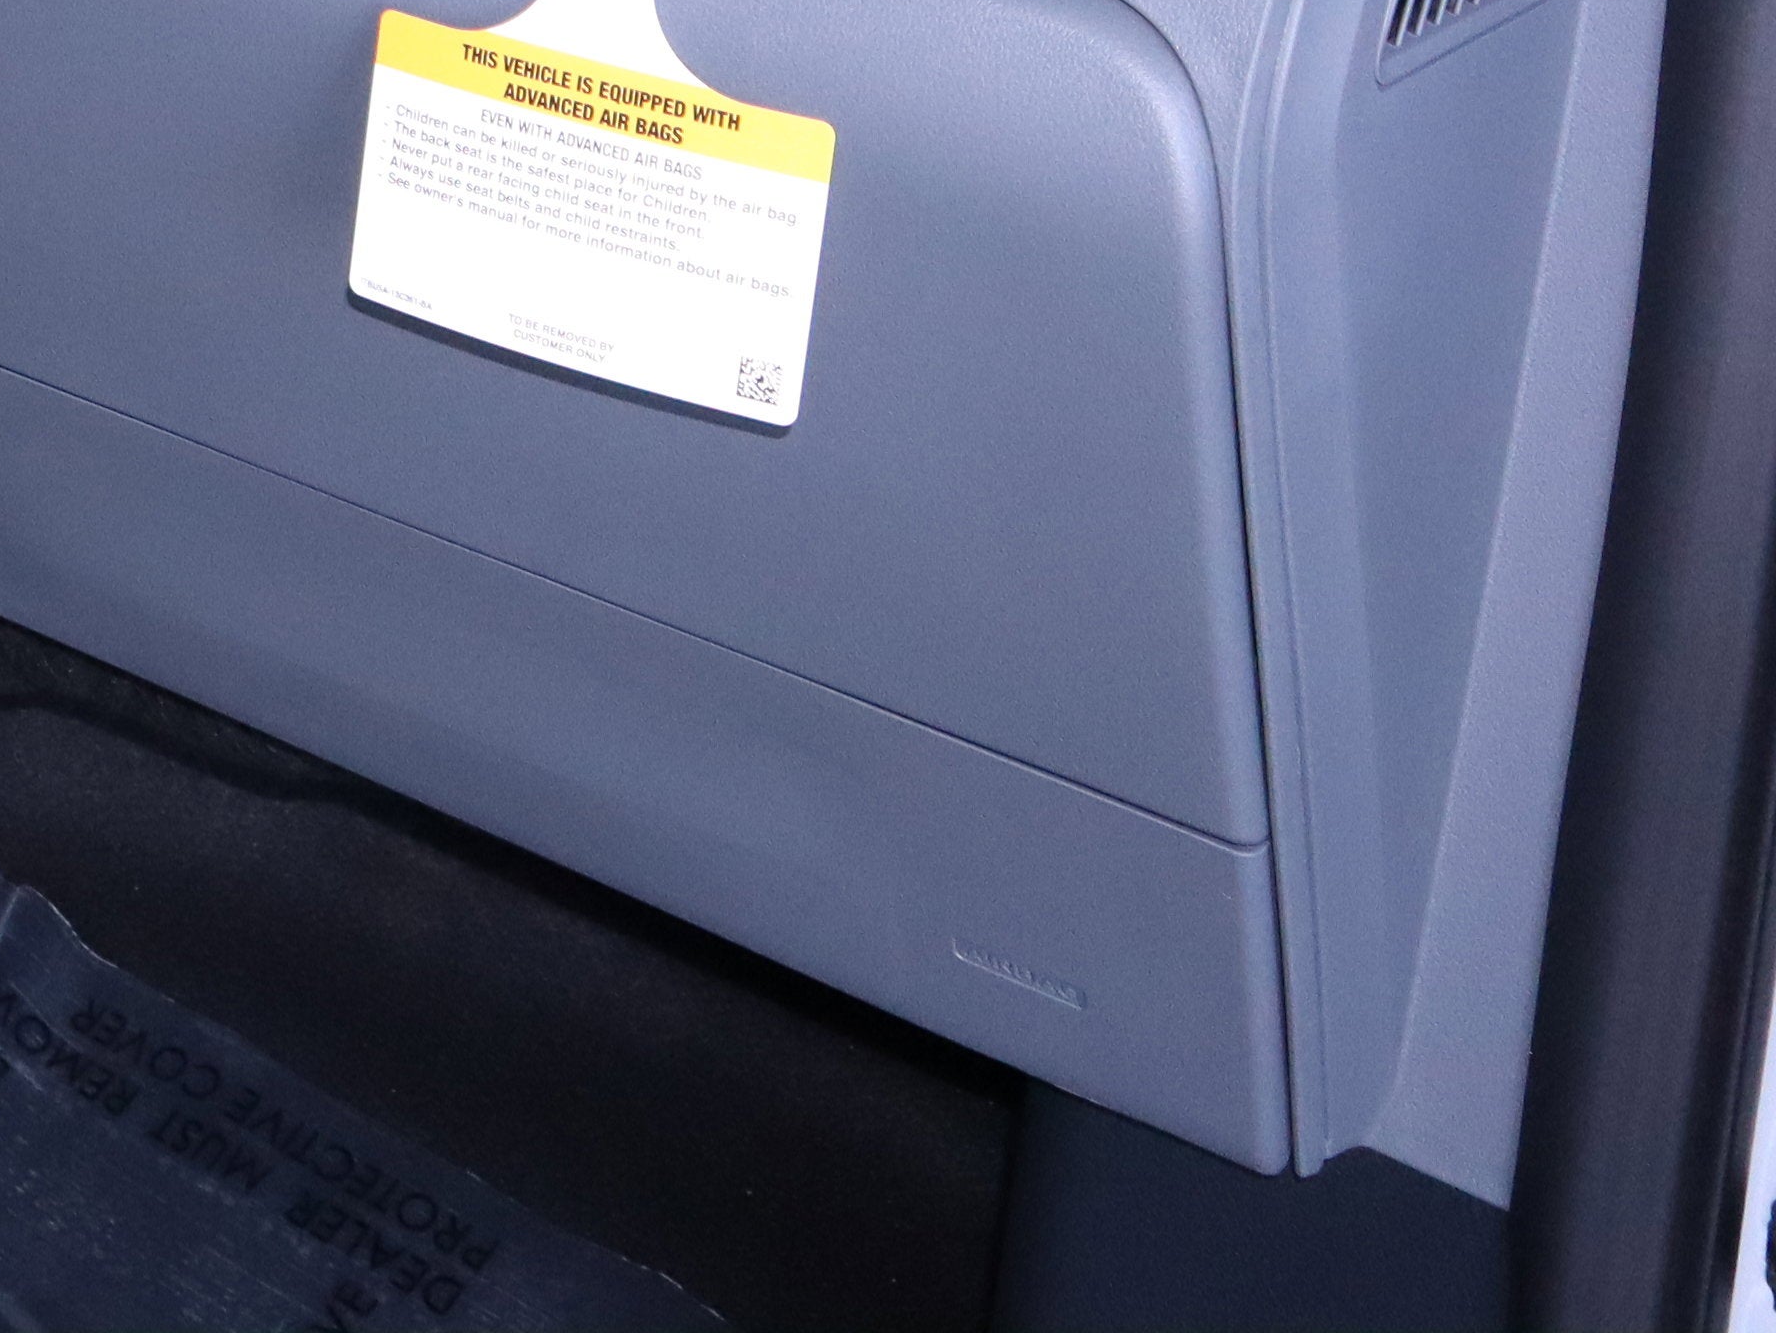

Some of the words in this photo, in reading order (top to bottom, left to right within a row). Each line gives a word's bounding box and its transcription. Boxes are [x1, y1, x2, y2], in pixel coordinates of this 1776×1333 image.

[462, 43, 499, 70] THIS
[503, 54, 572, 90] VEHICLE
[576, 75, 594, 95] IS
[598, 80, 687, 119] EQUIPPED
[692, 103, 741, 132] WITH
[503, 82, 595, 122] ADVANCED
[598, 108, 630, 132] AIR
[635, 116, 684, 145] BAGS
[392, 137, 428, 160] Never
[431, 153, 453, 168] put
[455, 161, 464, 172] a
[467, 165, 494, 181] rear
[498, 171, 541, 198] facing
[544, 188, 580, 206] child
[583, 199, 614, 216] seat
[618, 207, 632, 220] in
[637, 211, 660, 228] the
[394, 119, 417, 139] The
[420, 129, 451, 150] back
[454, 142, 482, 160] seat
[486, 152, 497, 164] is
[502, 155, 523, 172] the
[527, 164, 570, 185] safest
[573, 178, 613, 197] place
[617, 187, 638, 203] for
[395, 103, 449, 131] Children
[452, 124, 477, 139] can
[480, 130, 497, 146] be
[500, 136, 538, 158] killed
[541, 151, 556, 162] or
[560, 156, 628, 185] seriously
[632, 175, 685, 197] injured
[689, 187, 708, 206] by
[713, 194, 737, 210] the
[742, 203, 762, 215] air
[480, 108, 514, 130] EVEN
[518, 119, 553, 142] WITH
[555, 130, 630, 162] ADVANCED
[633, 151, 659, 170] AIR
[663, 158, 703, 181] BAGS
[387, 171, 411, 190] See
[413, 183, 464, 208] owner's
[468, 200, 518, 224] manual
[522, 214, 541, 231] for
[545, 224, 582, 243] more
[586, 236, 672, 267] information
[676, 260, 721, 281] about
[725, 273, 745, 286] air
[389, 155, 434, 181] Always
[438, 173, 462, 189] use
[465, 182, 494, 199] seat
[497, 189, 530, 211] belts
[534, 203, 561, 219] and
[565, 212, 601, 230] child
[508, 313, 523, 326] TO
[525, 318, 539, 331] BE
[542, 324, 596, 348] REMOVED
[599, 341, 614, 352] BY
[513, 328, 573, 354] CUSTOMER
[575, 348, 606, 363] ONLY
[68, 997, 224, 1101] COVER
[145, 1106, 277, 1194] MUST
[223, 1085, 500, 1273] PROTECTIVE
[285, 1189, 464, 1317] DEALER
